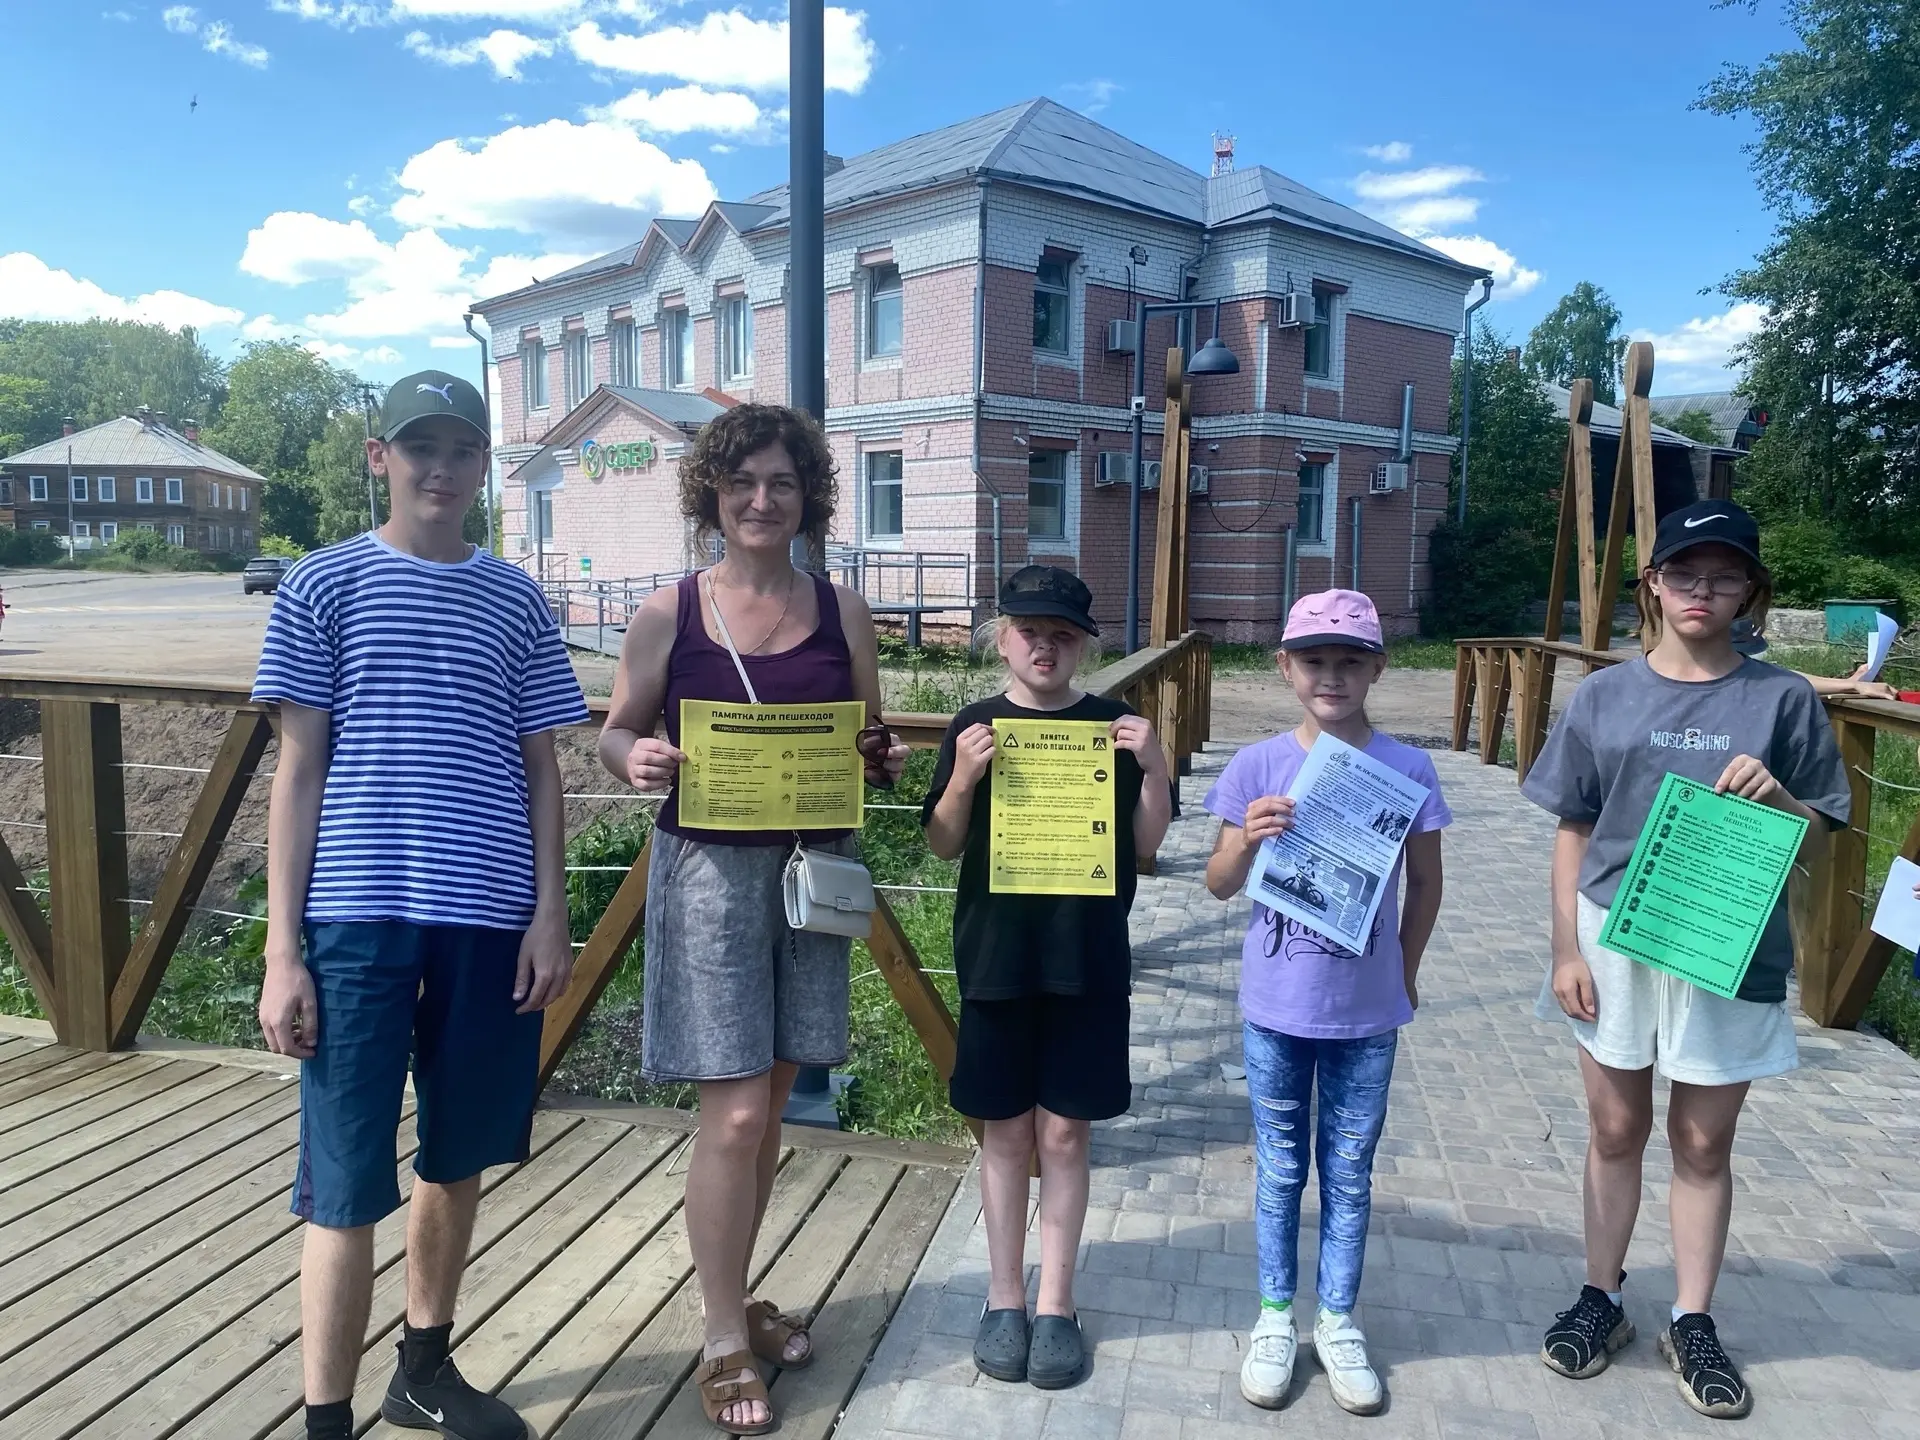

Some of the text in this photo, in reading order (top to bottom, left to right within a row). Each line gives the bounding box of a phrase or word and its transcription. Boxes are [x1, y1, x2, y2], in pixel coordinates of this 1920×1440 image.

[605, 441, 652, 469] СБЕР
[711, 710, 834, 722] ПАМЯТКА ДЛЯ ПЕШЕХОДОВ
[1040, 733, 1070, 741] ПАМЯТКА
[1024, 742, 1087, 752] ЮНОГО ПЕШЕХОДА
